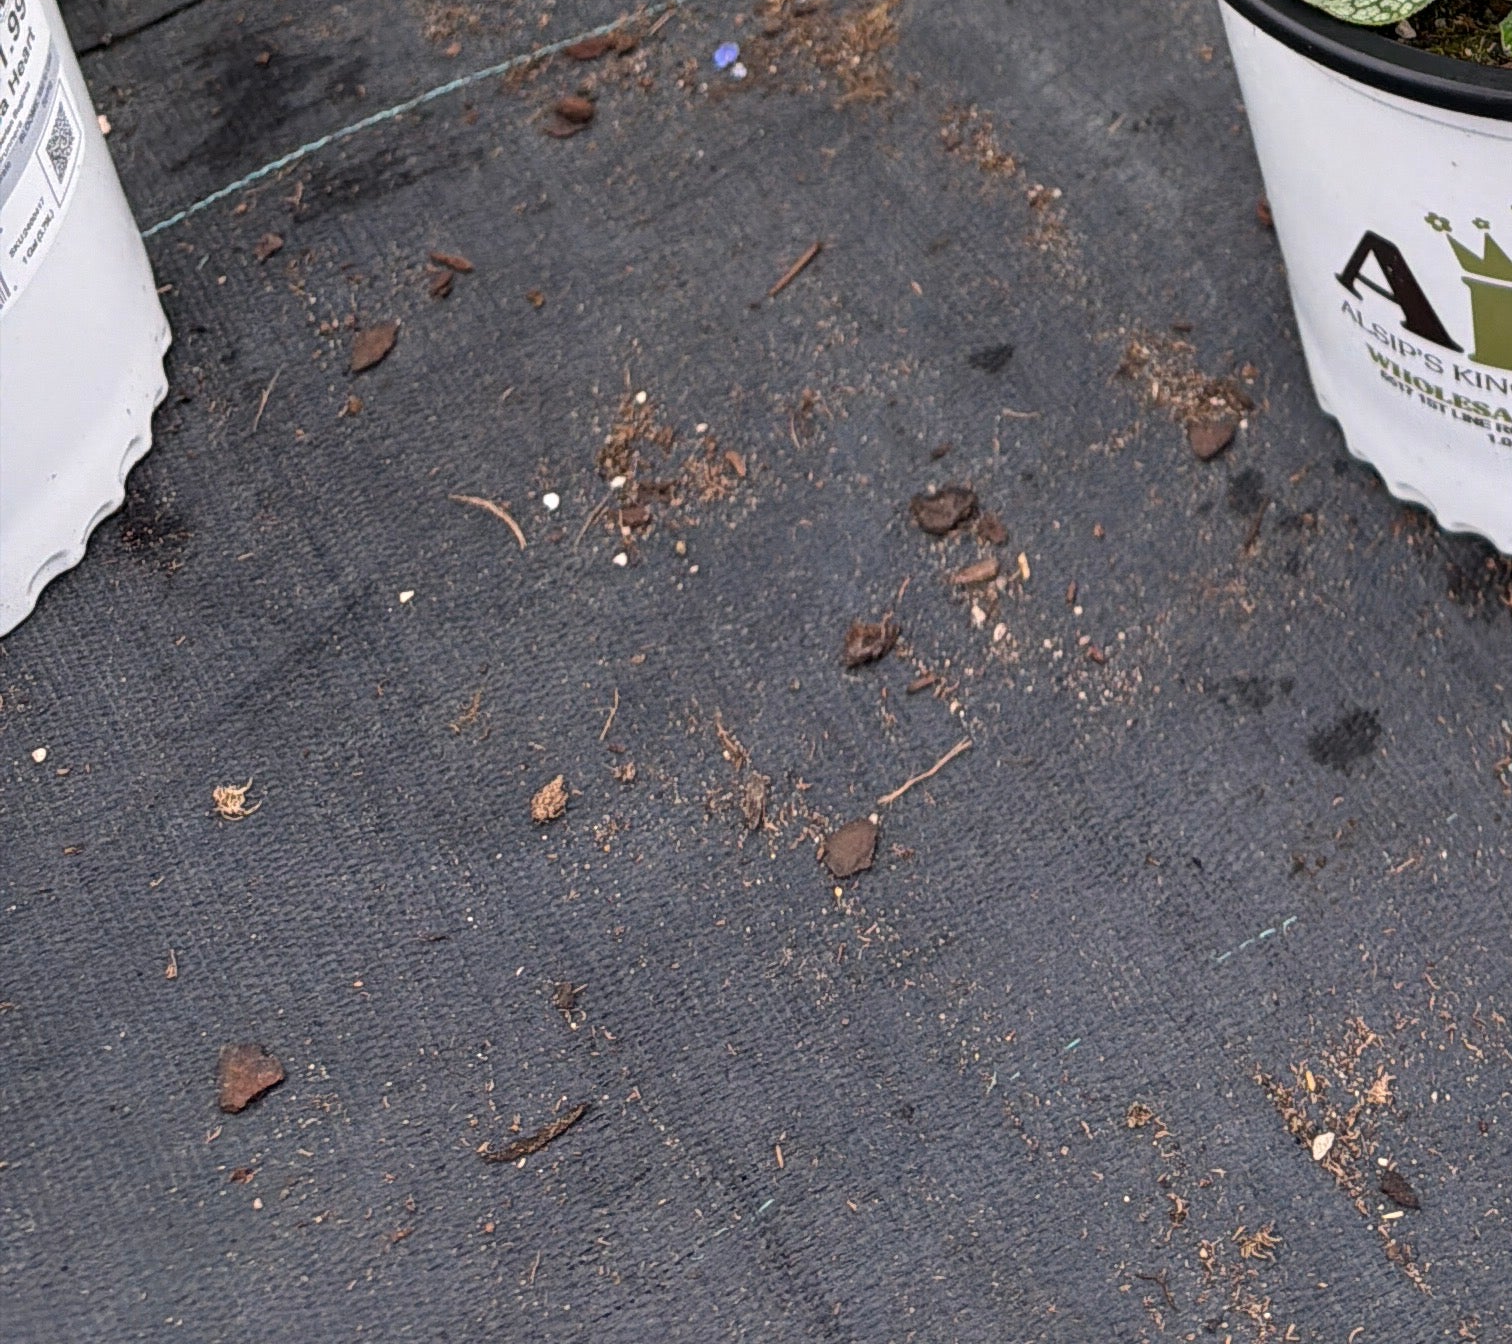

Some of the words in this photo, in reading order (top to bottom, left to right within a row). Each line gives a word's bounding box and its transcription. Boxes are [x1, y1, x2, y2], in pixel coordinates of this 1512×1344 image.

[8, 26, 36, 96] Heart
[1341, 299, 1444, 375] ALSIP'S
[1452, 408, 1492, 430] LINE
